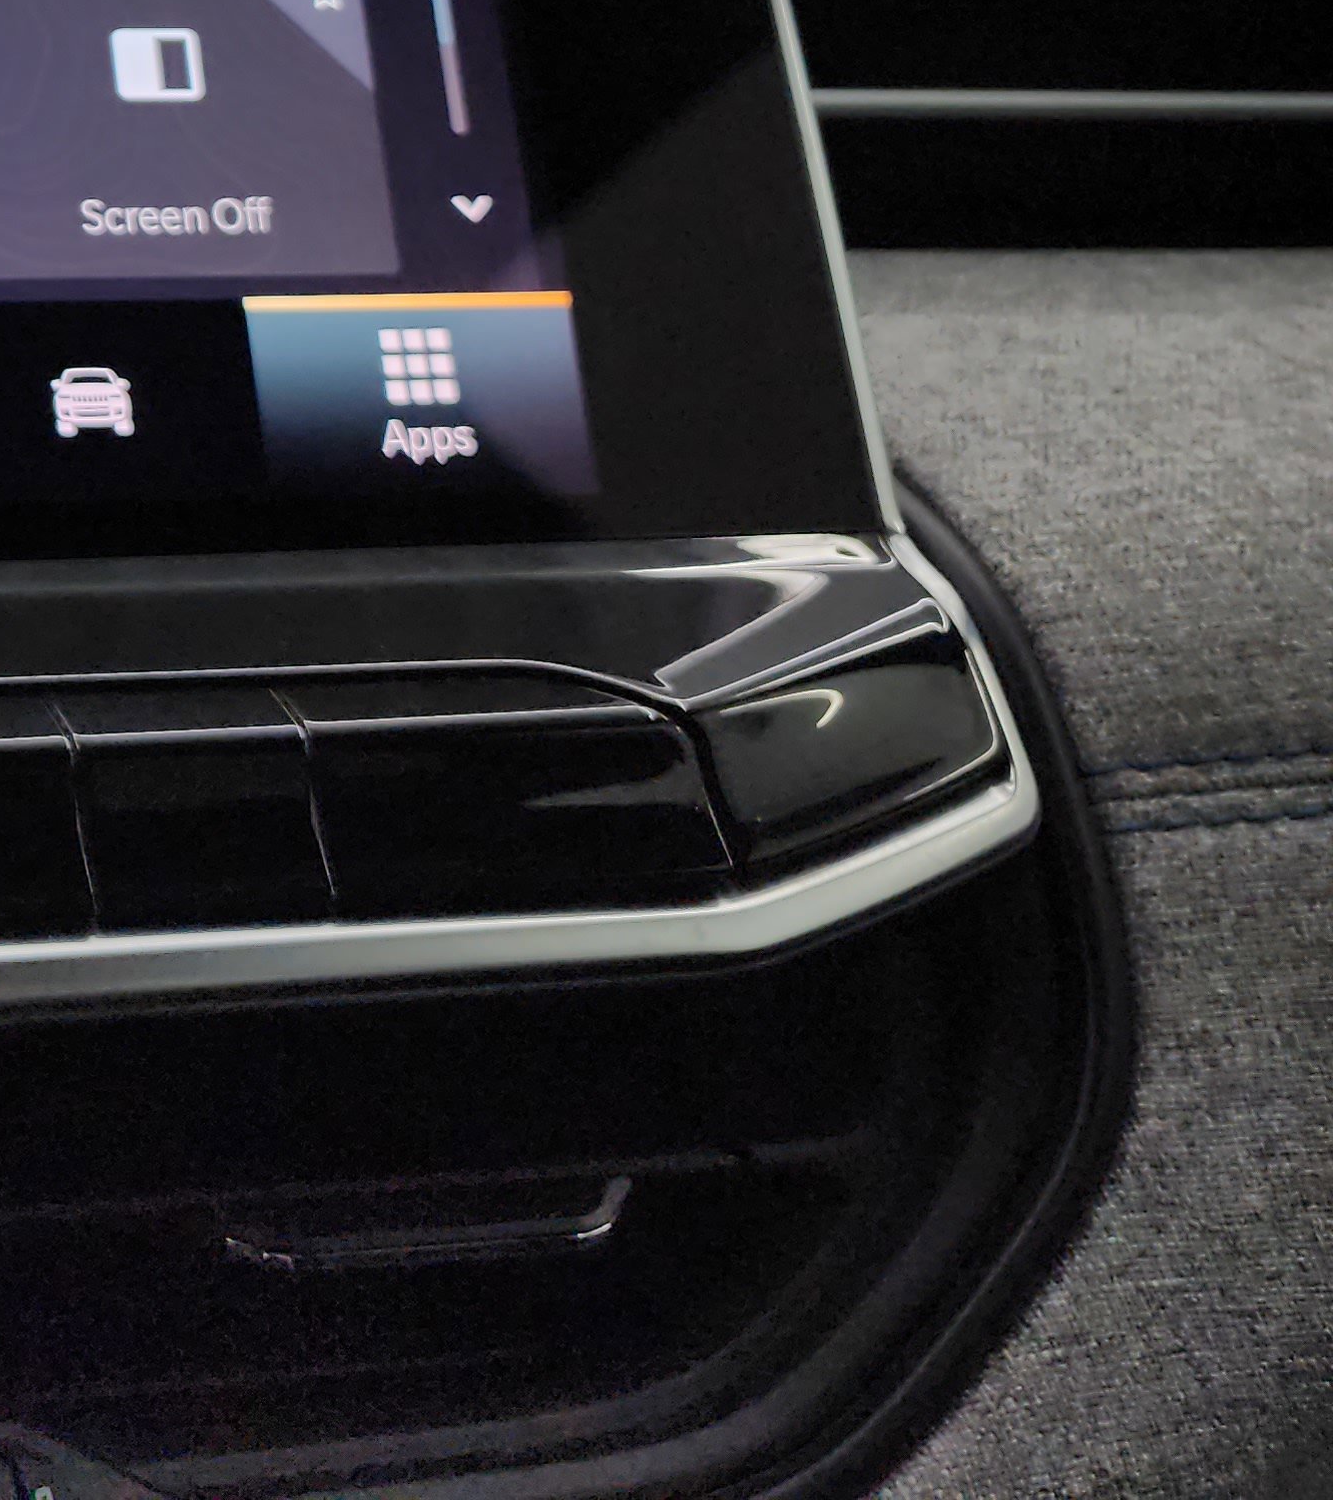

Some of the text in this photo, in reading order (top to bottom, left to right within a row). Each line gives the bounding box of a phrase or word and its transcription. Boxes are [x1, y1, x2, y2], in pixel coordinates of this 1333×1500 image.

[80, 196, 273, 236] Screen Off
[382, 418, 479, 466] Apps
